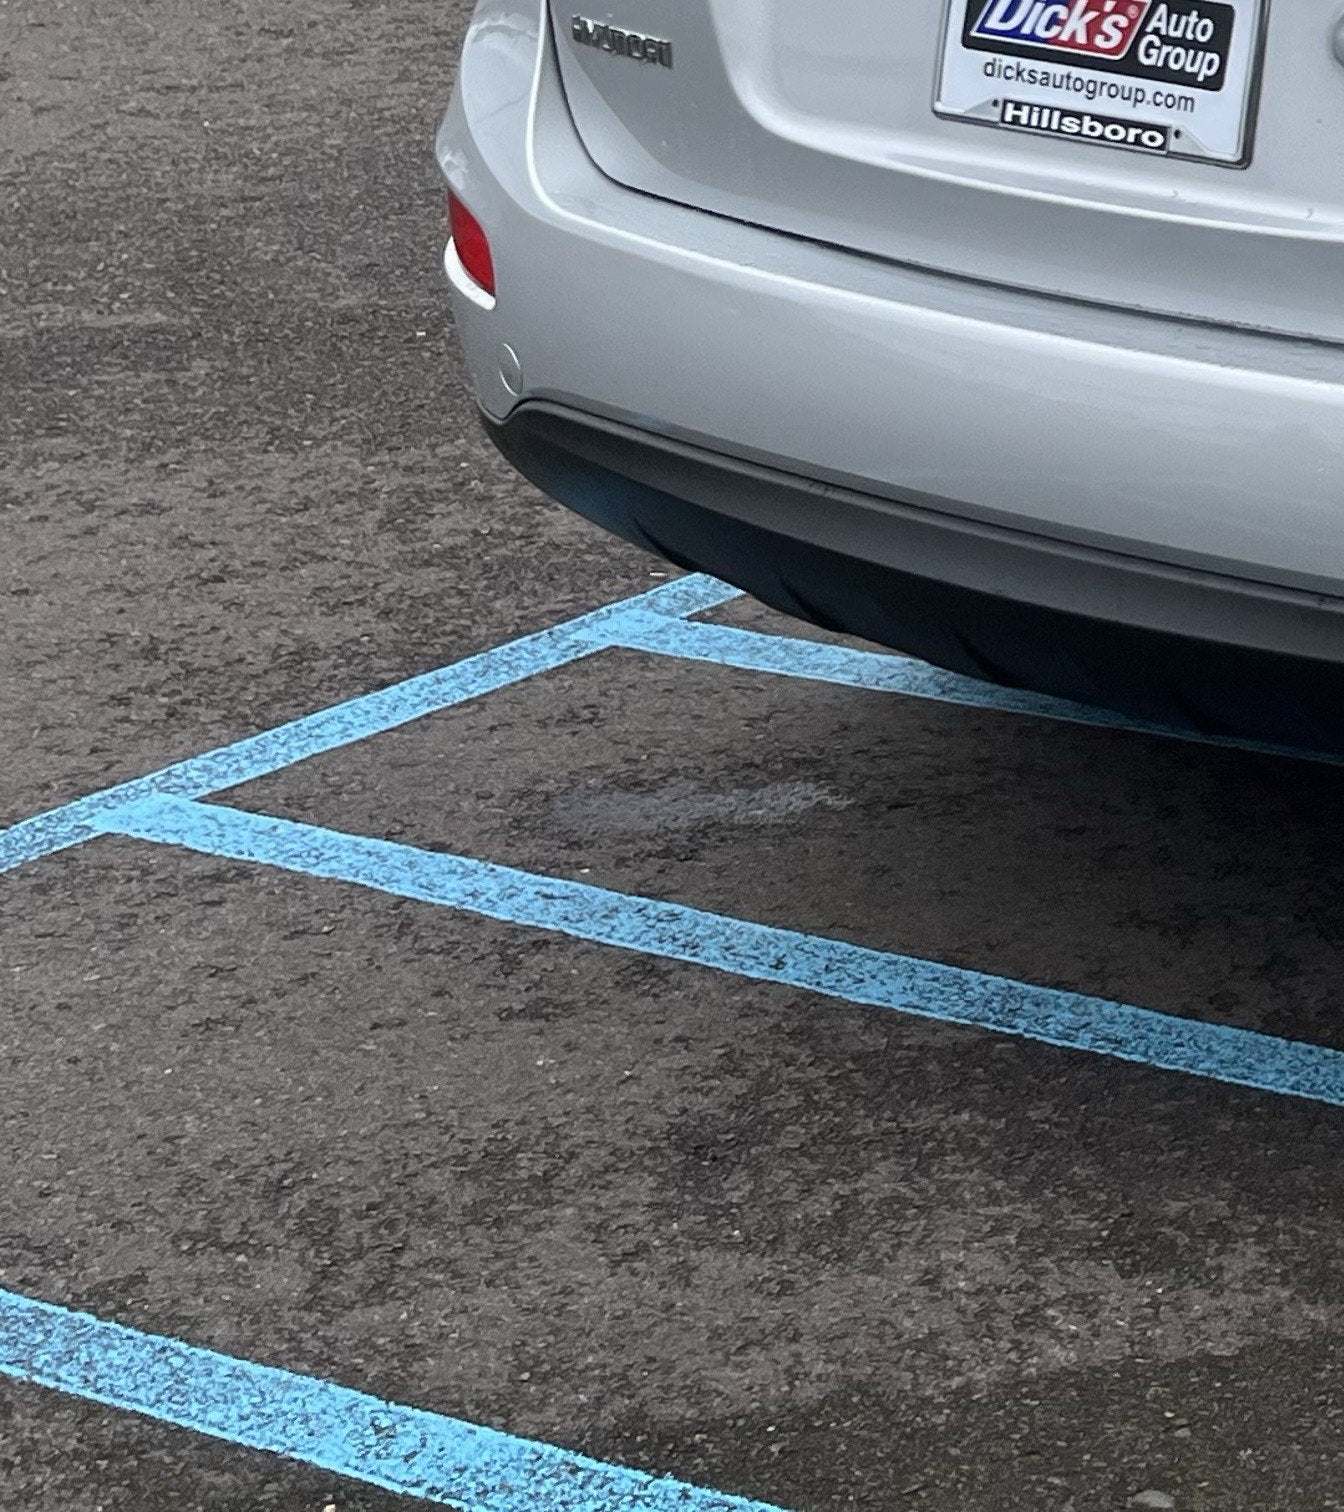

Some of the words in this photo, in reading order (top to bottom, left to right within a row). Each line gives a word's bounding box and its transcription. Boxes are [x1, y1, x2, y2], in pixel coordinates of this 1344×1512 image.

[1144, 2, 1215, 43] Auto
[1137, 33, 1221, 82] Group
[982, 56, 1197, 114] dicksautogroup.com
[1002, 99, 1165, 149] Hillsboro
